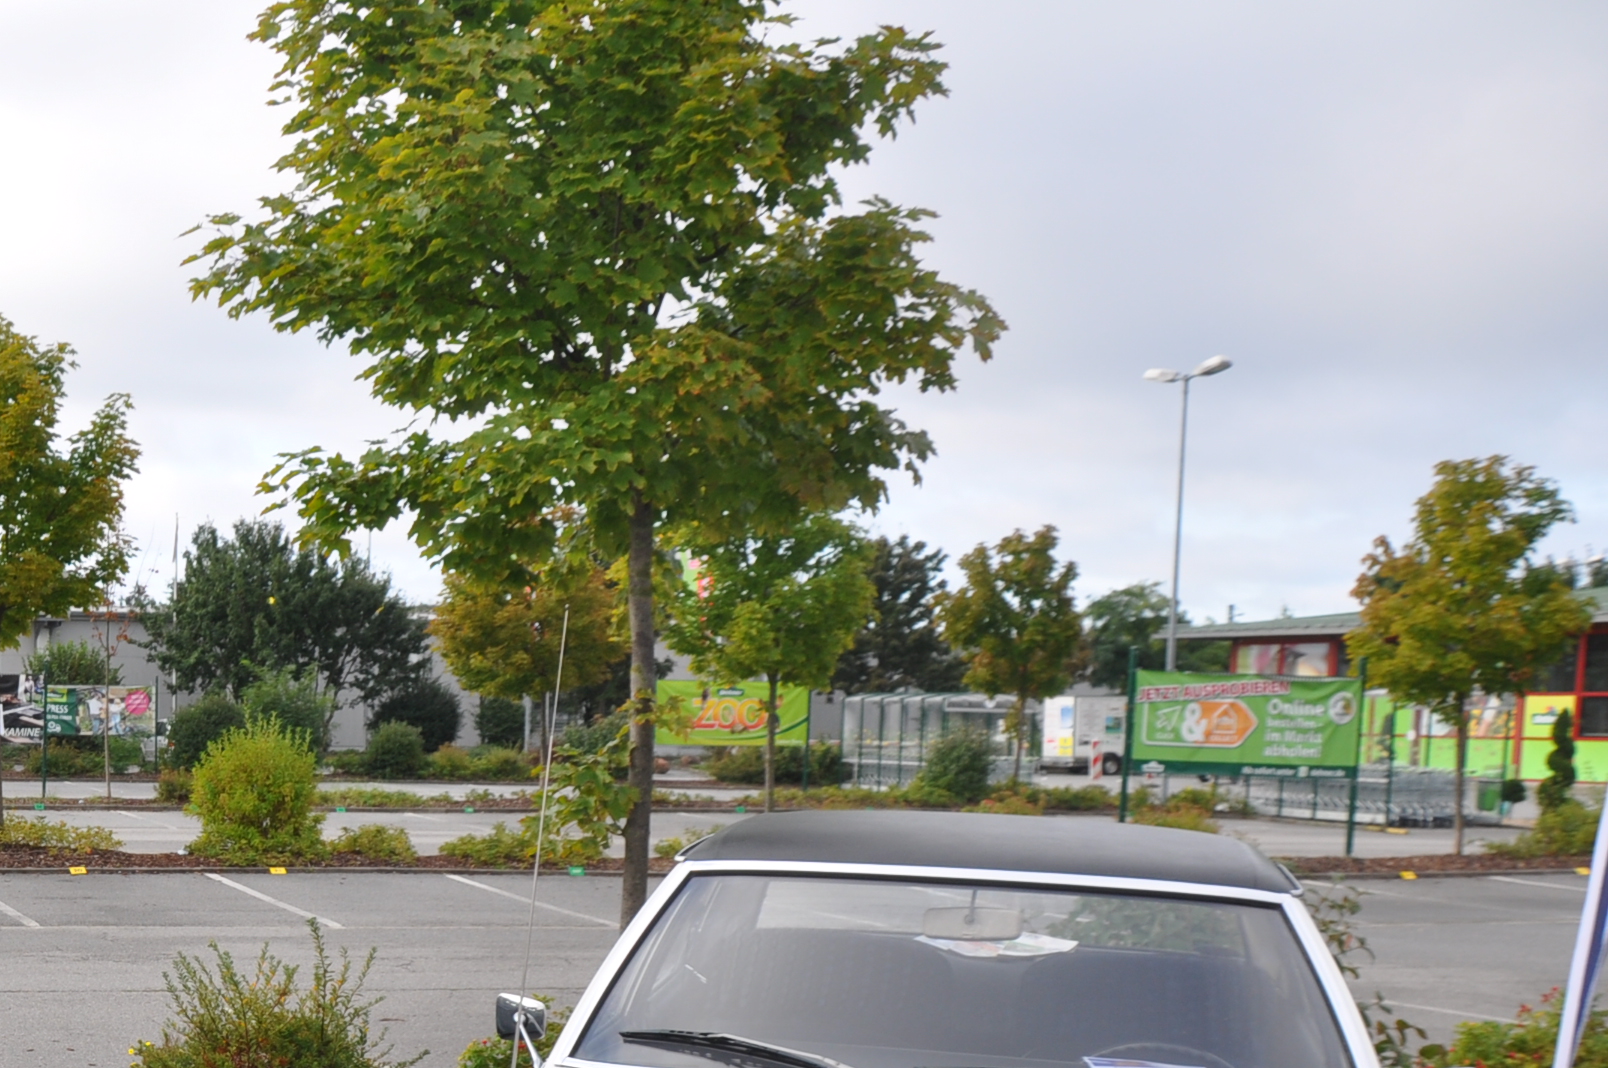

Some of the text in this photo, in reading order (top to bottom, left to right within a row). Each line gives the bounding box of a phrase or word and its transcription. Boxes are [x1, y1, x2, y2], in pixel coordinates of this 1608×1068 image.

[1139, 681, 1290, 701] JETZT AUSPROBIEREN
[692, 697, 768, 731] ZOO
[1268, 699, 1325, 716] Online
